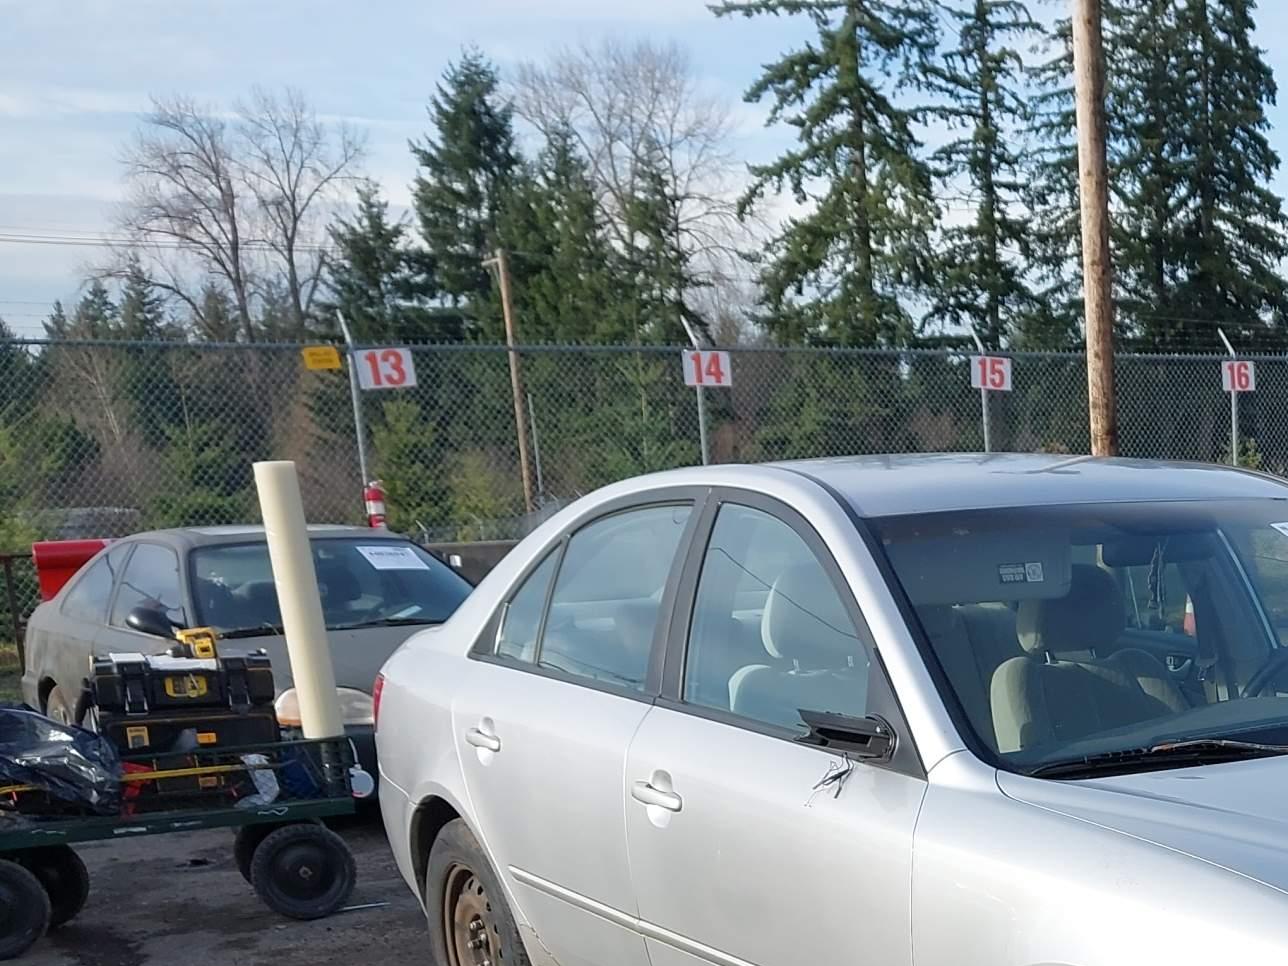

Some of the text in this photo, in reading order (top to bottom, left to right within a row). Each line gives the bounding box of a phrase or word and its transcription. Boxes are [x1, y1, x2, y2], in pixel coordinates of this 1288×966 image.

[364, 349, 406, 385] 13
[691, 351, 724, 384] 14
[978, 358, 1005, 388] 15
[1227, 362, 1250, 390] 16
